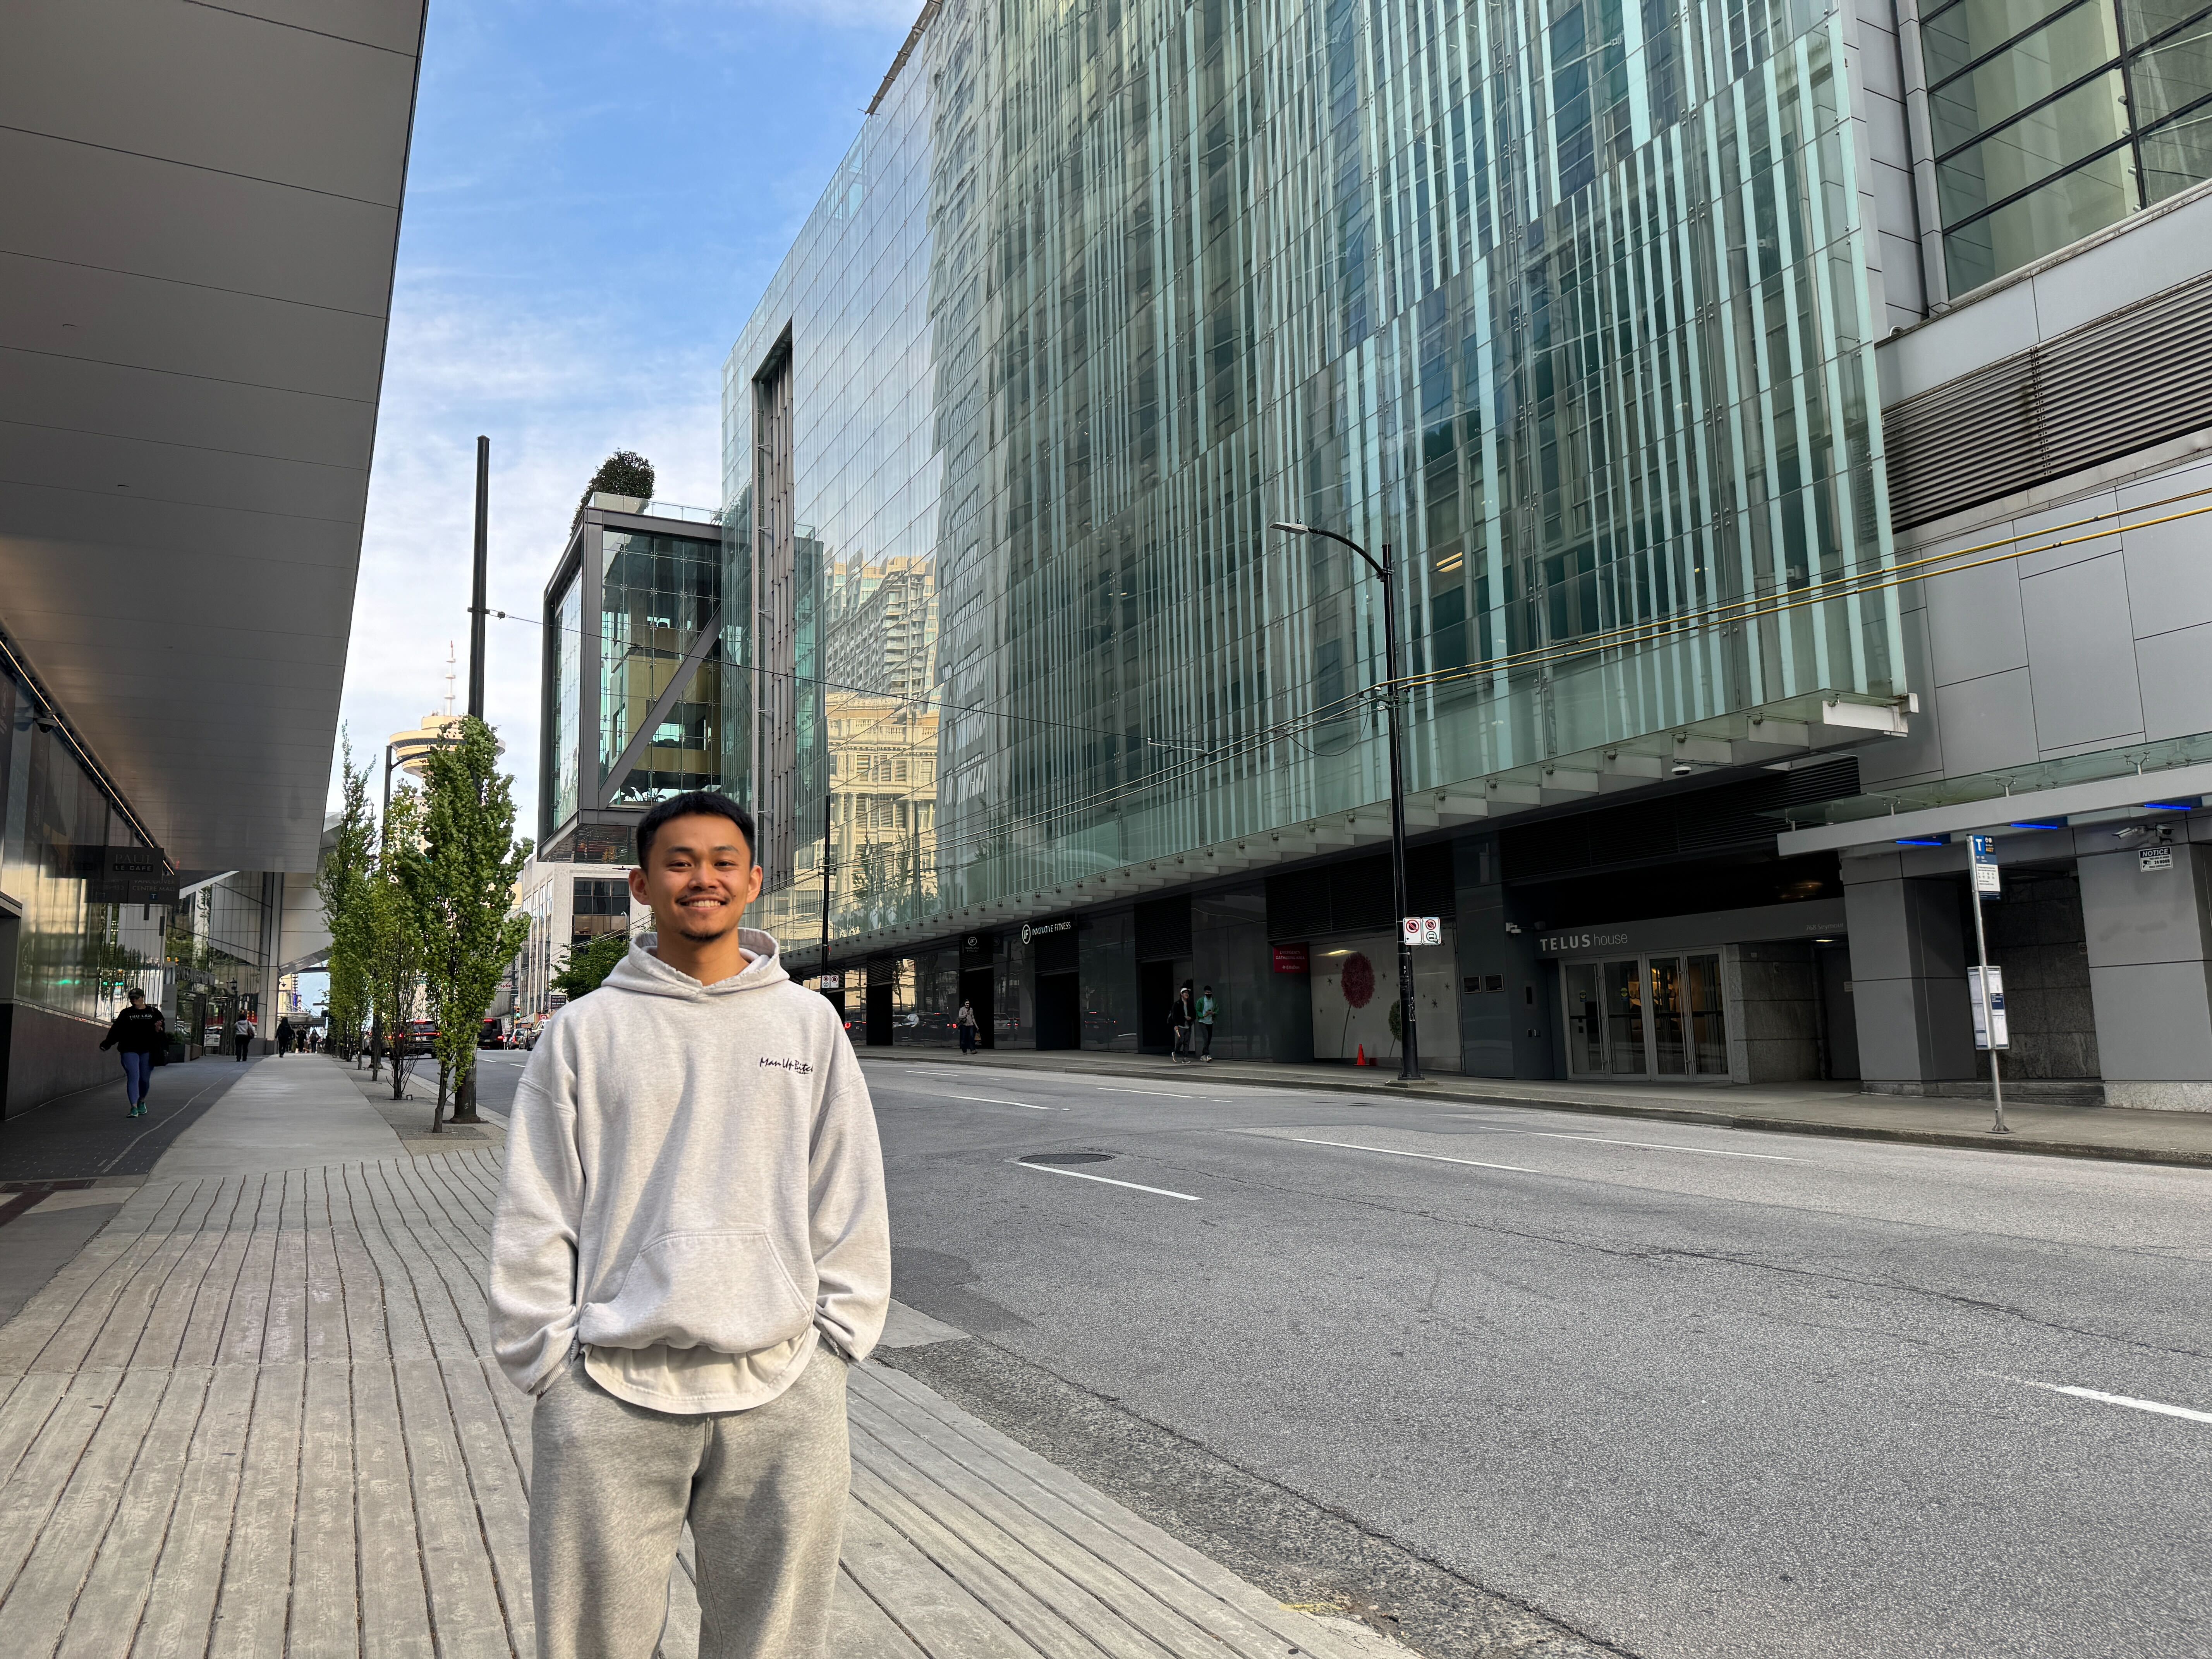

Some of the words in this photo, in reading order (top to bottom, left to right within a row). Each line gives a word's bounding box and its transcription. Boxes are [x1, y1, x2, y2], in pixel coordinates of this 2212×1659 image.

[1975, 838, 1982, 851] T
[2142, 848, 2169, 857] NOTICE
[115, 854, 152, 864] PAUL
[1054, 922, 1071, 931] FITNESS
[1540, 934, 1590, 951] TELUS
[1594, 933, 1628, 946] house
[760, 1057, 781, 1067] Man
[782, 1058, 794, 1070] Up
